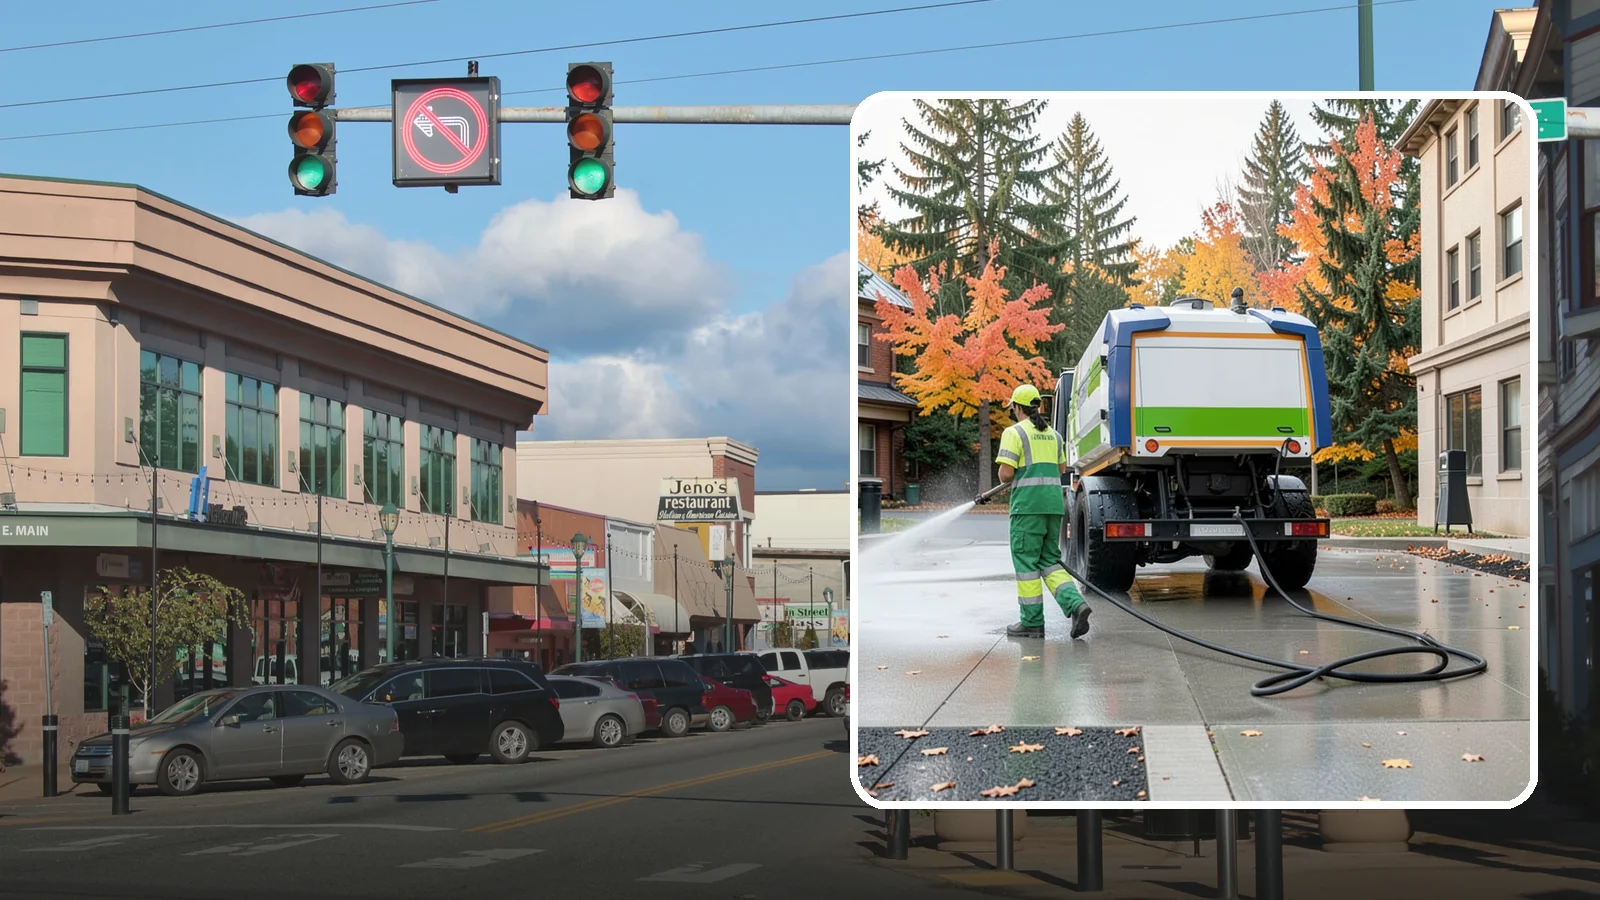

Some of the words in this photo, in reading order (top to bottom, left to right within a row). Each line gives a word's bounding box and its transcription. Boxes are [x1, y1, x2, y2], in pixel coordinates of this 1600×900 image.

[670, 480, 727, 494] Jeno's
[665, 496, 731, 509] restaurant
[658, 510, 682, 519] Italian
[686, 510, 715, 519] American
[715, 510, 737, 519] Cuisine
[2, 525, 13, 536] E.
[15, 525, 49, 536] MAIN
[797, 607, 828, 616] Street
